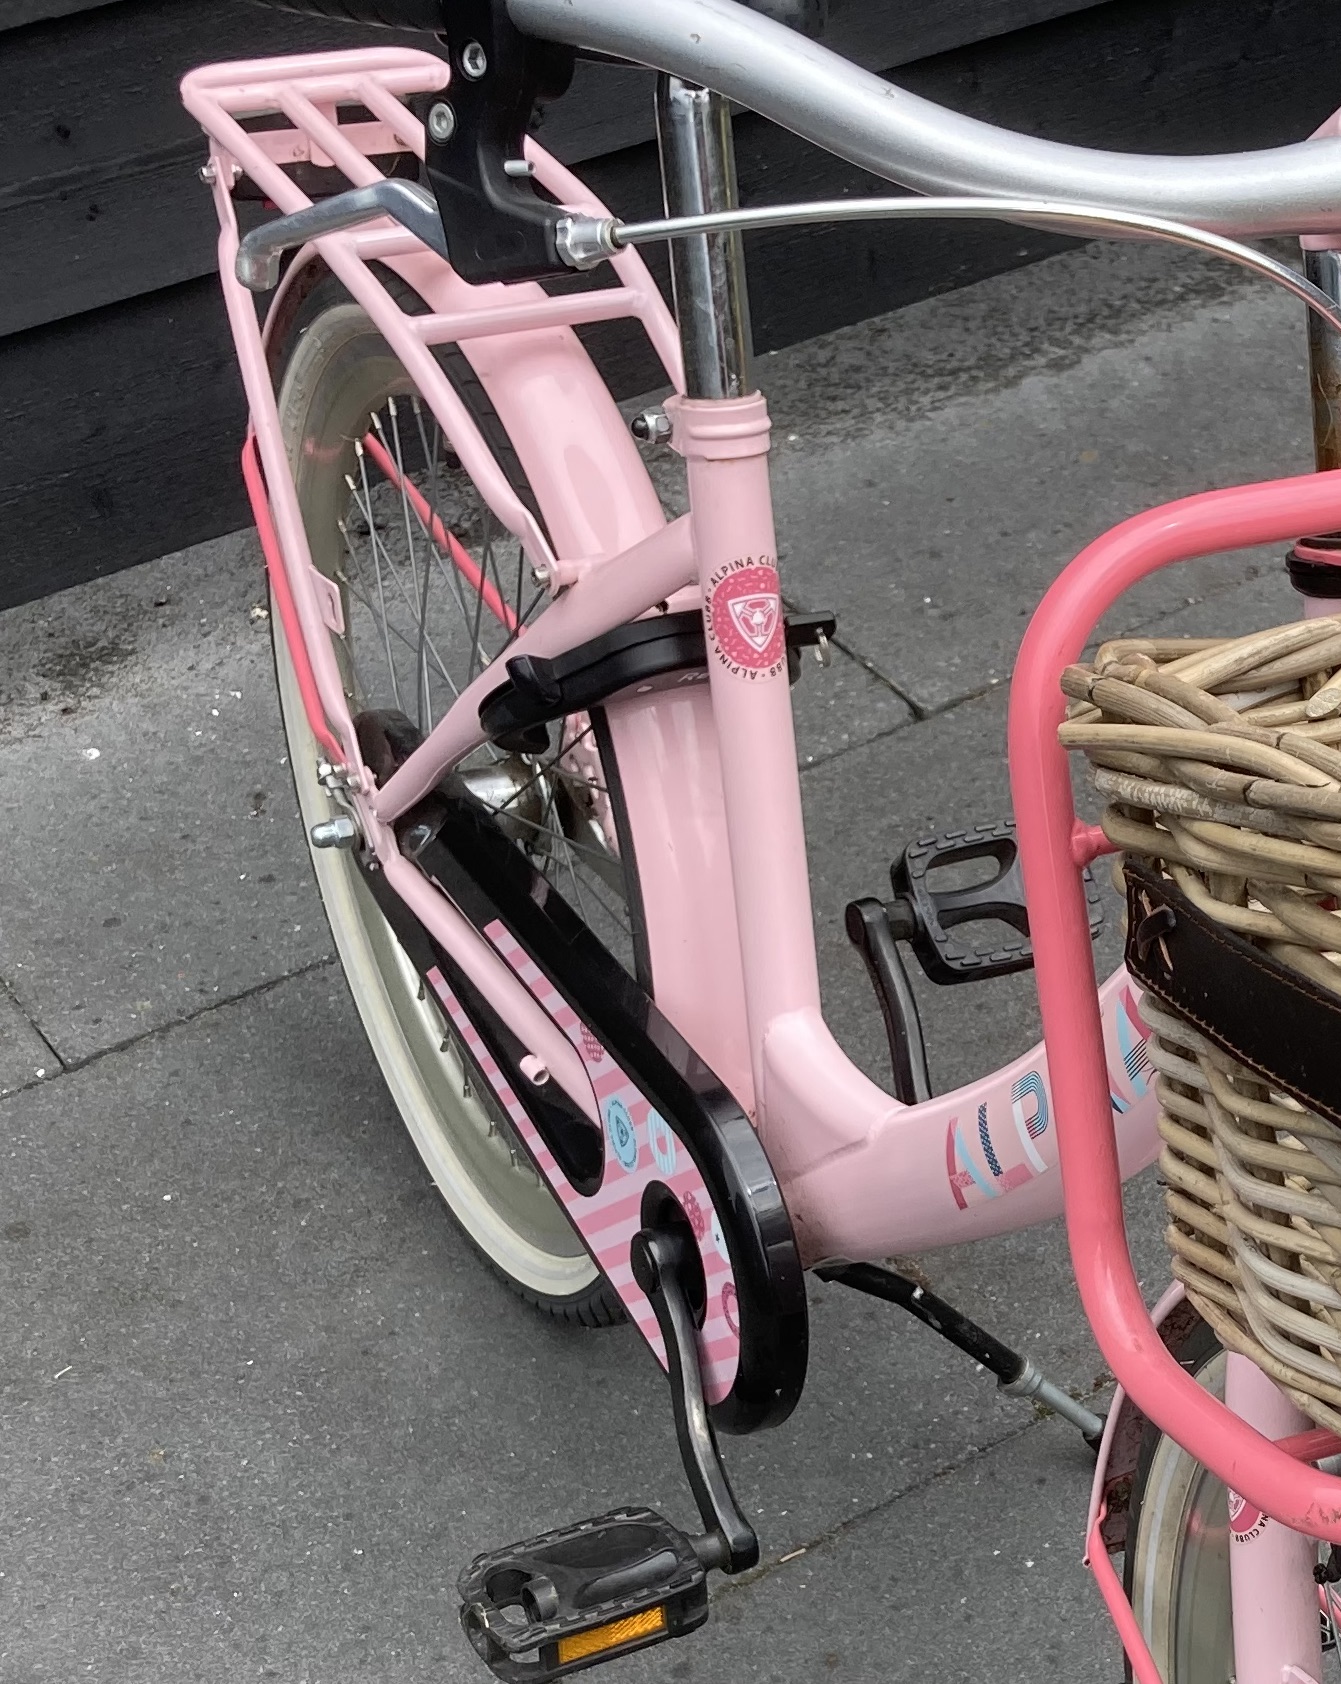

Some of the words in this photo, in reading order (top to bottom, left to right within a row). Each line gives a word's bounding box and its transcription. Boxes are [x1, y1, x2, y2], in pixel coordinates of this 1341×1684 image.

[710, 556, 755, 588] ALPINA
[758, 554, 777, 568] CLU
[714, 645, 758, 680] ALPINA
